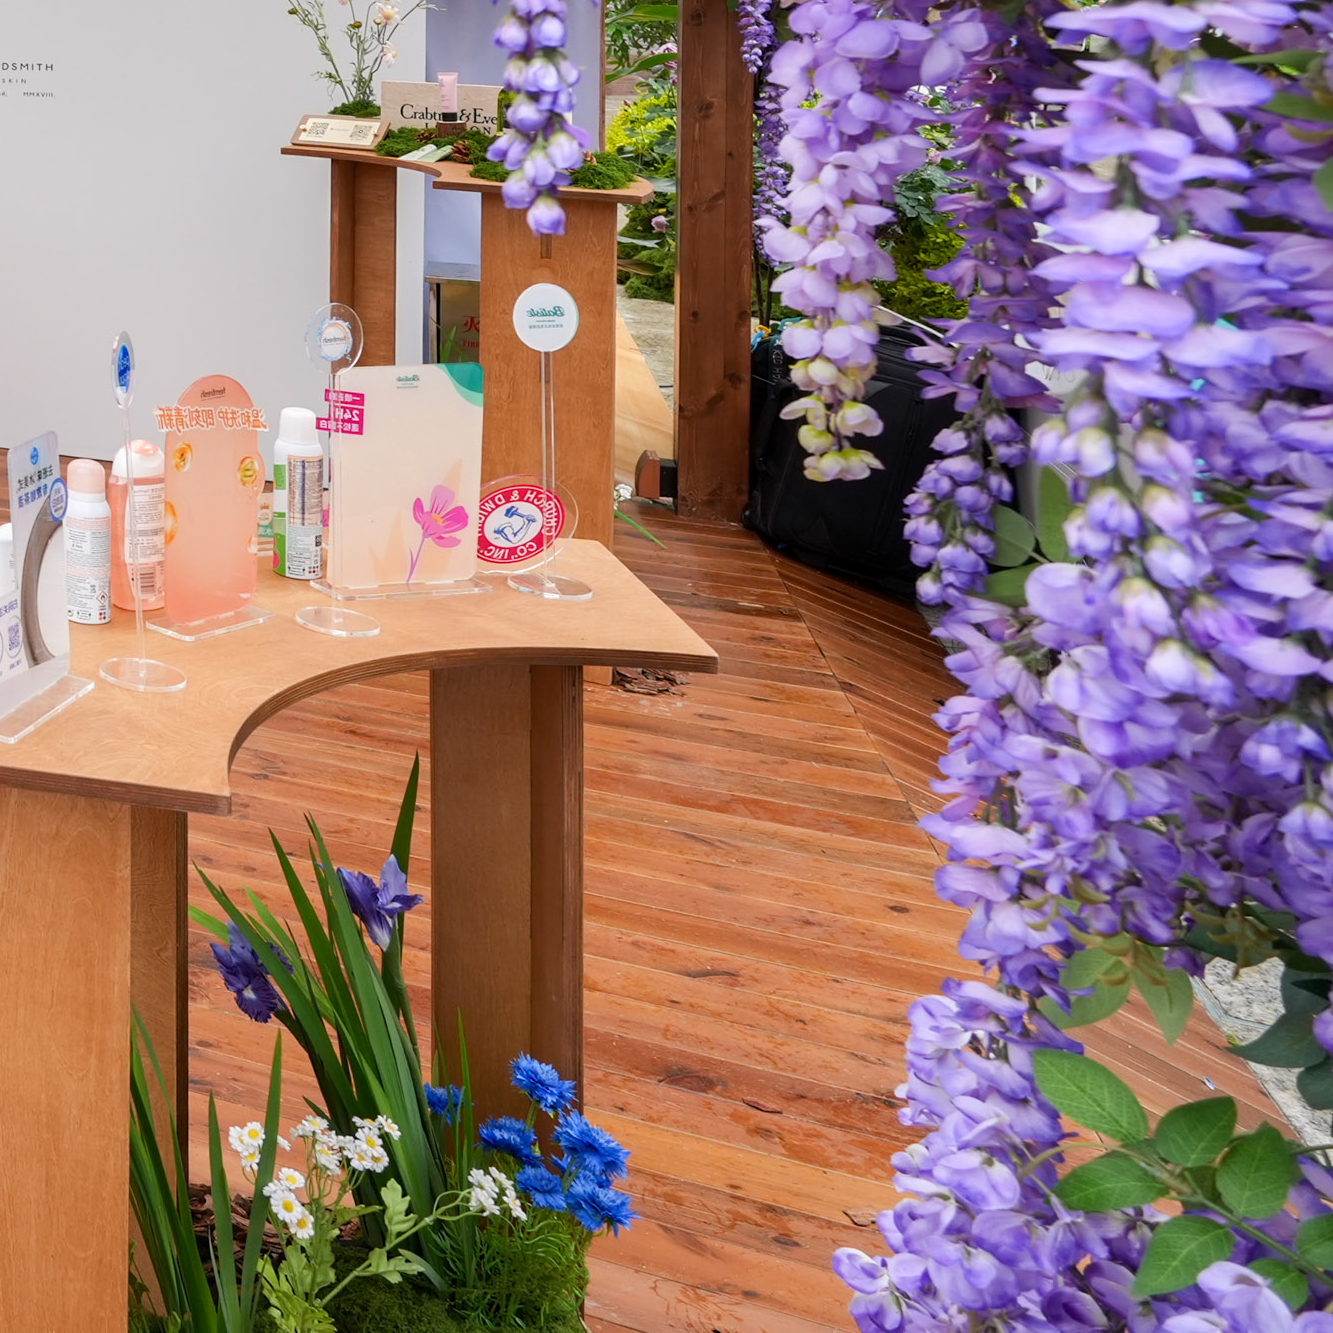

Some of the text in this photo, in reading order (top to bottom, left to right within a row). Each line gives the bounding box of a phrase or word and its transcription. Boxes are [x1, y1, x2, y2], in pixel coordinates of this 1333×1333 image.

[400, 103, 498, 125] Crabtr & Eve
